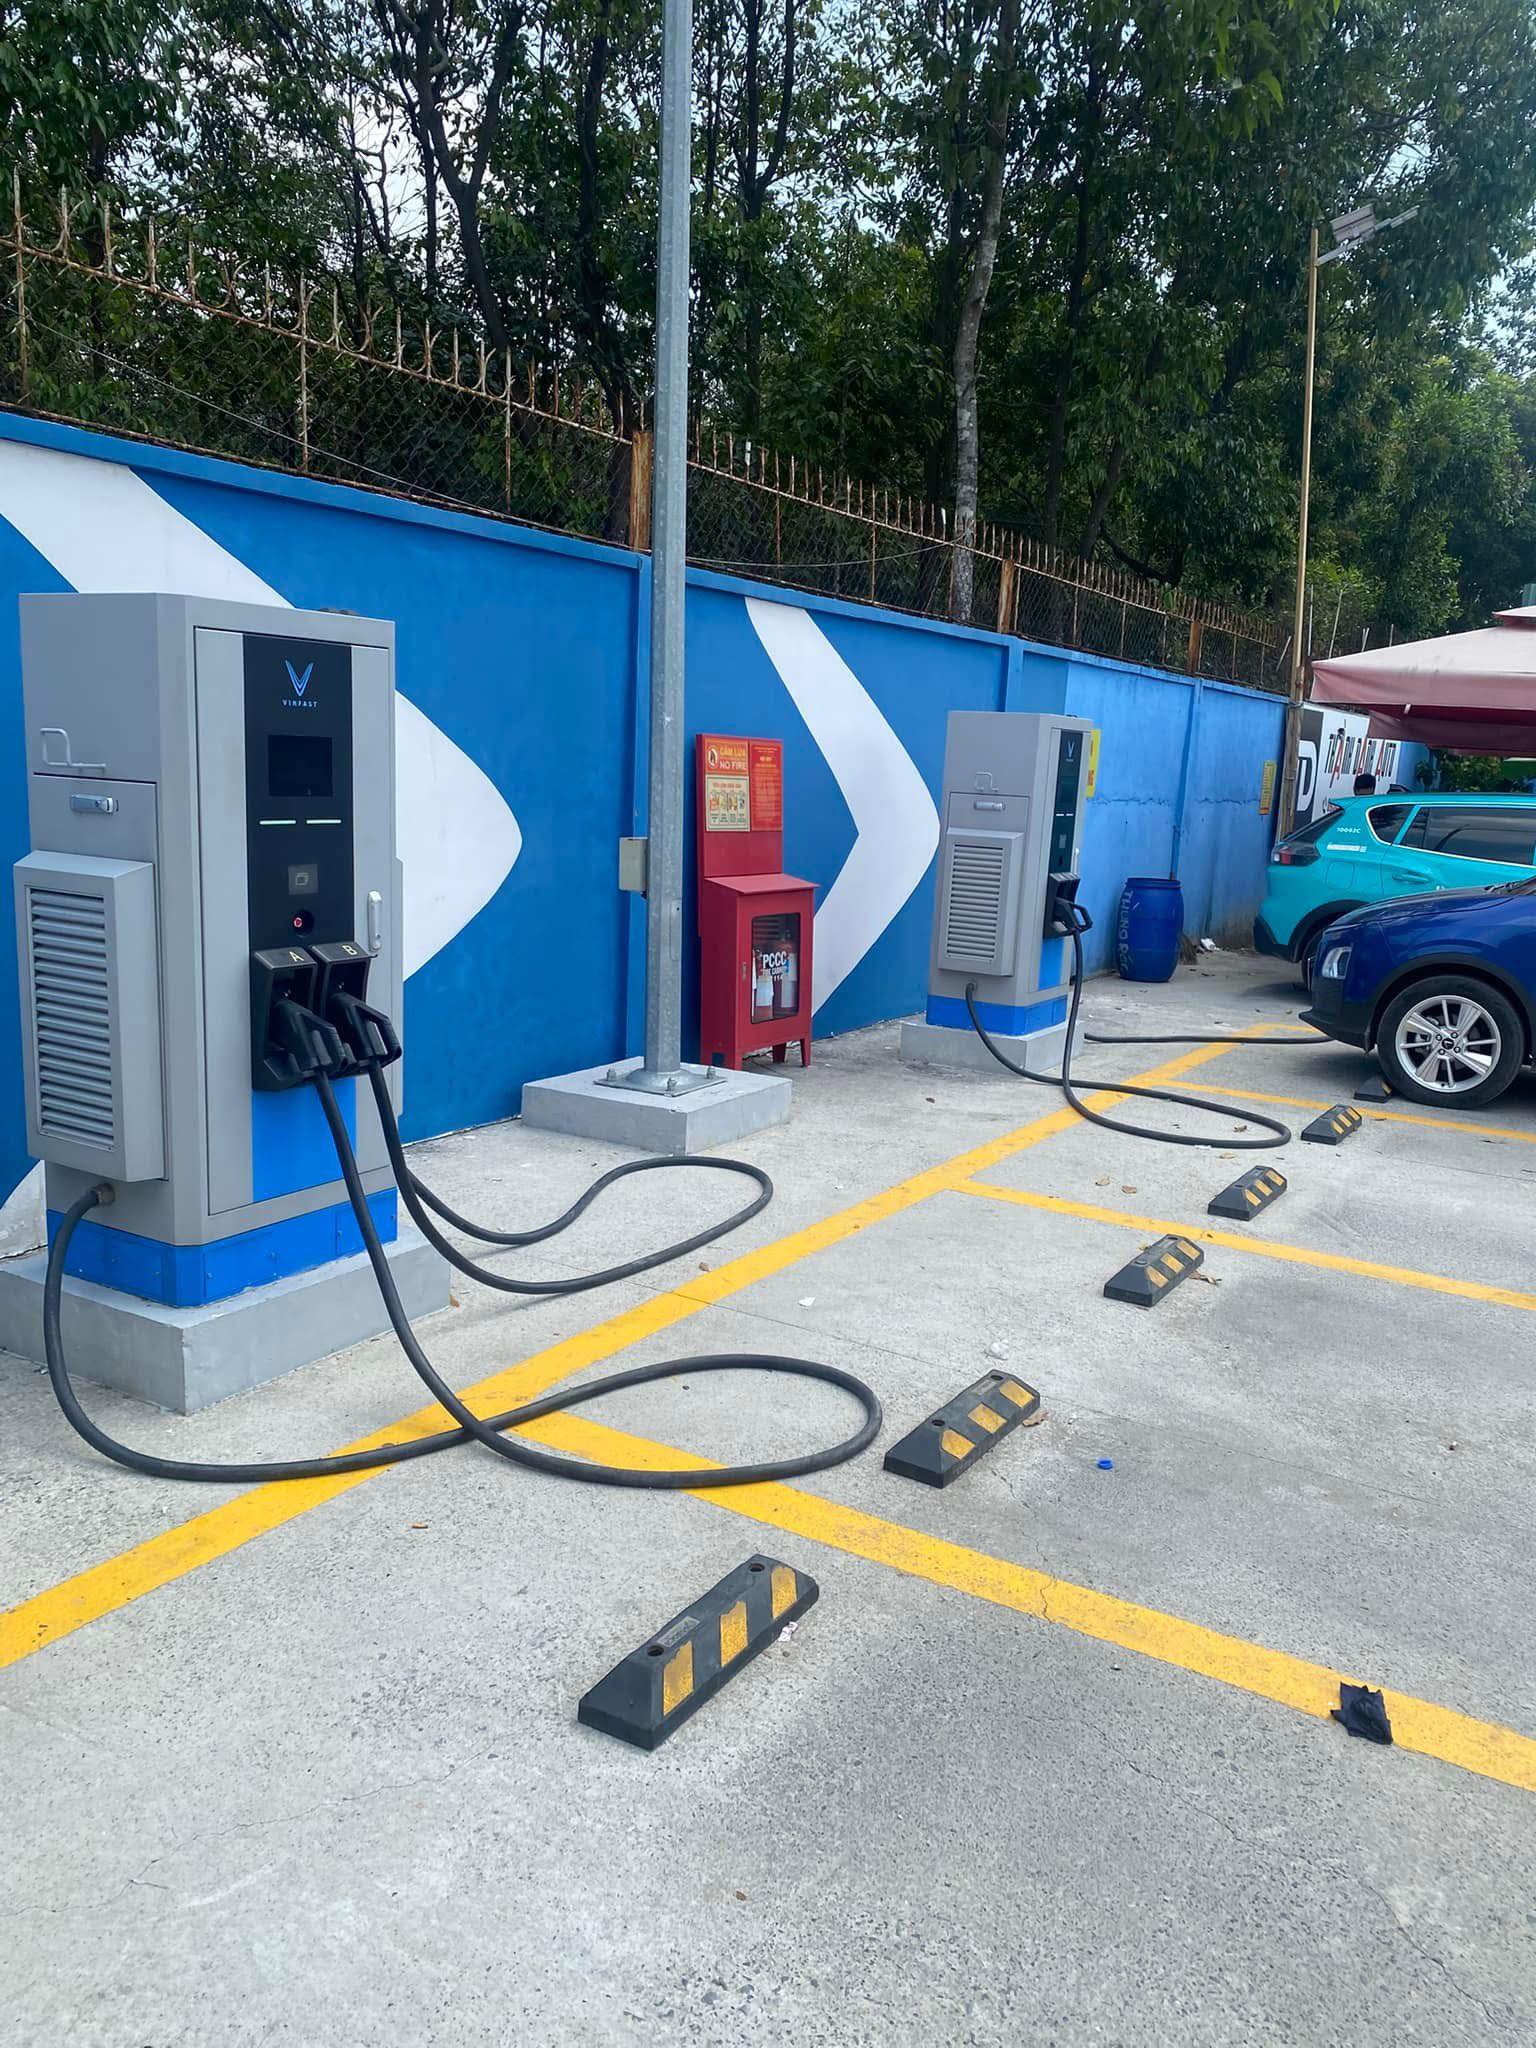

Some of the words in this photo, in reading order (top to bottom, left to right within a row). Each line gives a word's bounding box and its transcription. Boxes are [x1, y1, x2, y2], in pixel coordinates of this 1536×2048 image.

[282, 698, 317, 709] VINFAST
[719, 760, 731, 769] NO
[732, 761, 747, 771] FIRE
[288, 950, 305, 962] A
[342, 944, 358, 956] B
[762, 950, 787, 969] PCCC
